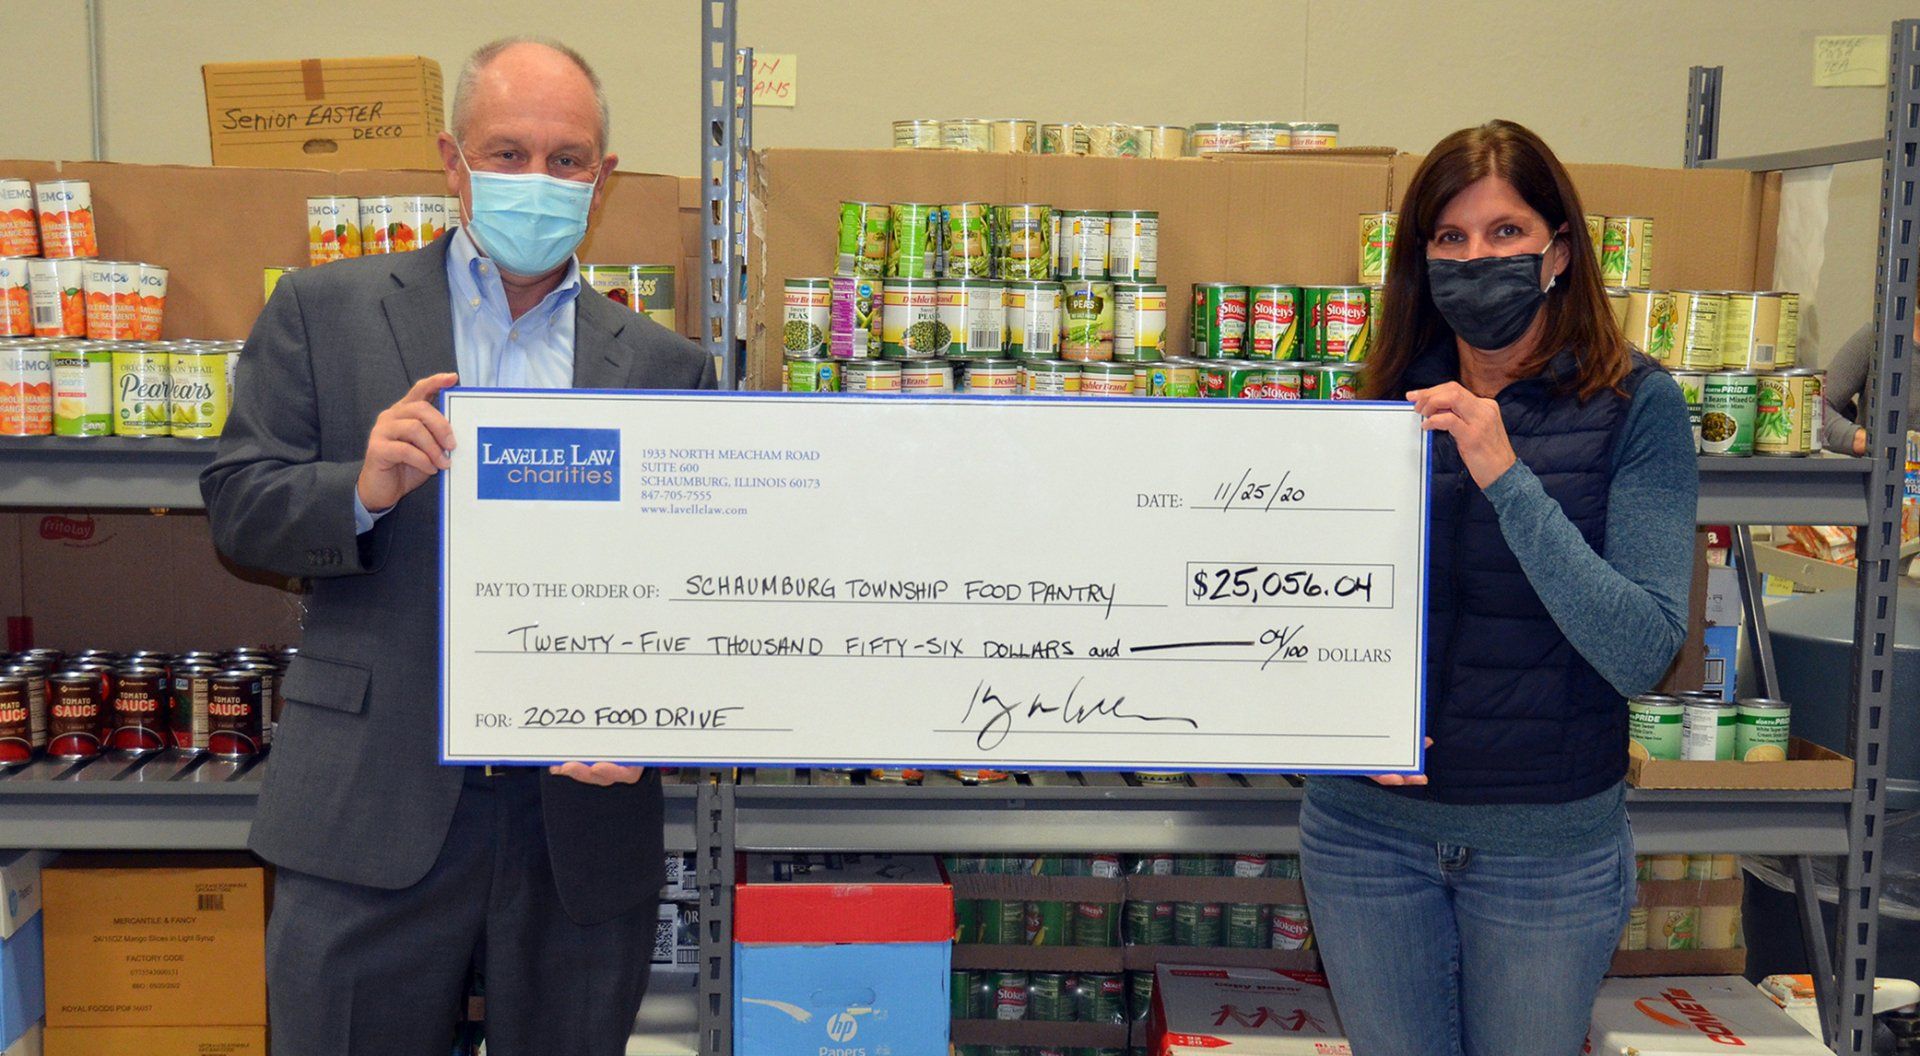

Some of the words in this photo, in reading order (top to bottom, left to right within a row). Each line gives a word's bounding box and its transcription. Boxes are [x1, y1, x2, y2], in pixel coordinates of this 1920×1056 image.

[222, 108, 297, 131] Senior
[305, 101, 384, 126] EASTER
[352, 124, 404, 140] DECCO
[1073, 300, 1095, 310] PEAS
[1254, 302, 1294, 319] Stokely's
[1326, 303, 1366, 320] Stokely's
[788, 312, 809, 320] PEAS
[1721, 384, 1749, 394] PRIDE
[482, 443, 565, 465] LAVELLE
[570, 444, 615, 466] LAW
[641, 448, 667, 459] 1933
[669, 448, 716, 460] NORTH
[718, 449, 783, 461] MEACHAM
[785, 450, 821, 461] ROAD
[641, 462, 677, 473] SUITE
[679, 463, 700, 473] 600
[507, 466, 613, 484] charities
[641, 476, 732, 488] SCHAUMBURG,
[734, 477, 787, 488] ILLINOIS
[789, 478, 821, 489] 60173
[641, 490, 713, 500] 847-705-7555
[1136, 493, 1184, 508] DATE:
[1213, 468, 1306, 512] 11/25/20
[641, 504, 748, 515] www.lavellelaw.com
[1193, 566, 1373, 604] $25,056.04
[475, 582, 504, 598] PAY
[505, 583, 531, 598] TO
[532, 583, 568, 598] THE
[571, 584, 629, 599] ORDER
[632, 584, 660, 599] OF:
[686, 574, 837, 599] SCHAUMBURG
[845, 579, 949, 600] TOWNSHIP
[964, 580, 1022, 601] FOOD
[1028, 580, 1117, 620] PANTRY
[708, 636, 824, 657] THOUSAND
[846, 637, 964, 658] FIFTY-SIX
[983, 640, 1075, 659] DOLLARS
[1088, 638, 1121, 658] and
[1317, 648, 1392, 663] DOLLARS
[62, 697, 91, 705] TOMATO
[120, 692, 149, 700] TOMATO
[213, 696, 241, 704] TOMATO
[0, 701, 20, 710] MATO
[54, 704, 97, 718] SAUCE
[114, 698, 156, 712] SAUCE
[208, 702, 249, 716] SAUCE
[475, 713, 513, 728] FOR:
[524, 706, 586, 728] 2020
[595, 707, 648, 727] FOOD
[655, 706, 745, 730] DRIVE
[1635, 712, 1661, 723] PRIDE
[113, 917, 162, 926] MERCANTILE
[171, 917, 198, 925] FANCY
[126, 954, 161, 962] FACTORY
[163, 954, 184, 962] CODE
[62, 1005, 87, 1013] ROYAL
[829, 1012, 857, 1043] hp
[819, 1046, 865, 1056] Papers
